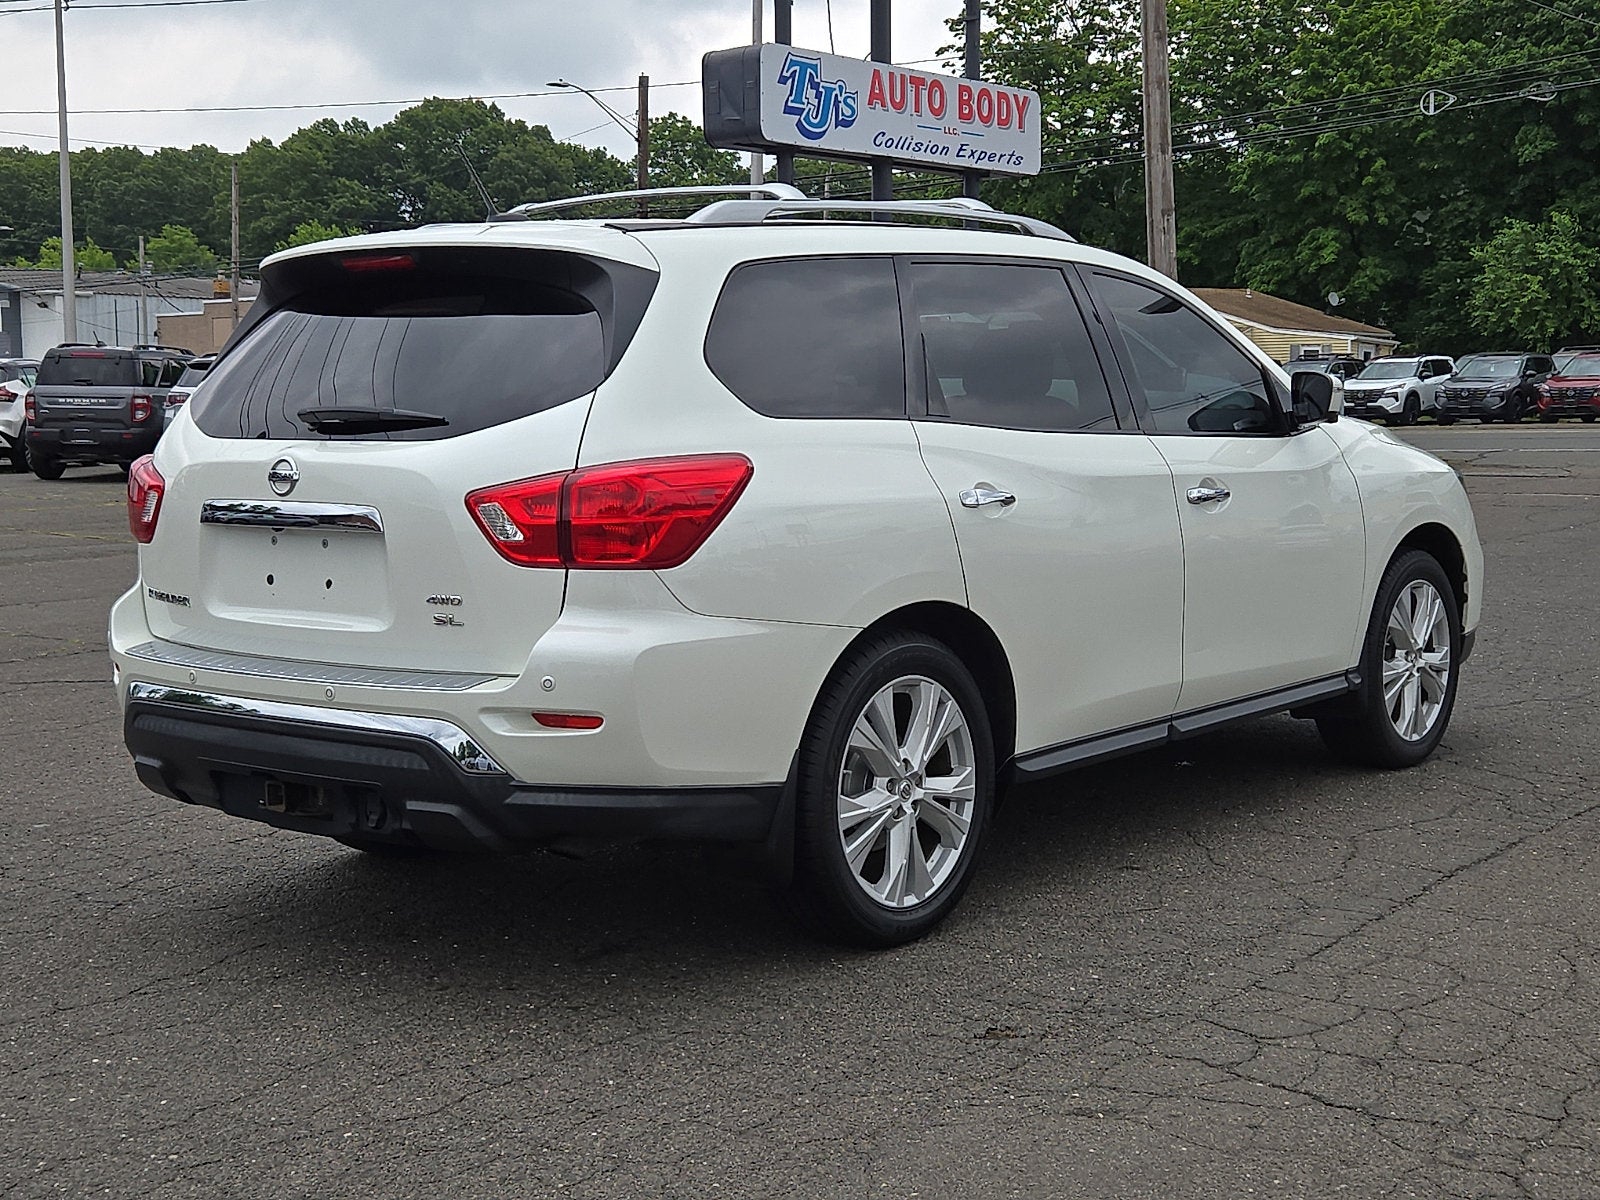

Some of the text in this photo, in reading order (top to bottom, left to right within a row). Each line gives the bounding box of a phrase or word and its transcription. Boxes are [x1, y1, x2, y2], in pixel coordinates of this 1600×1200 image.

[866, 68, 1030, 133] AUTO BODY
[872, 131, 1025, 167] Collision Experts
[426, 594, 463, 606] 4WD
[433, 612, 465, 626] SL
